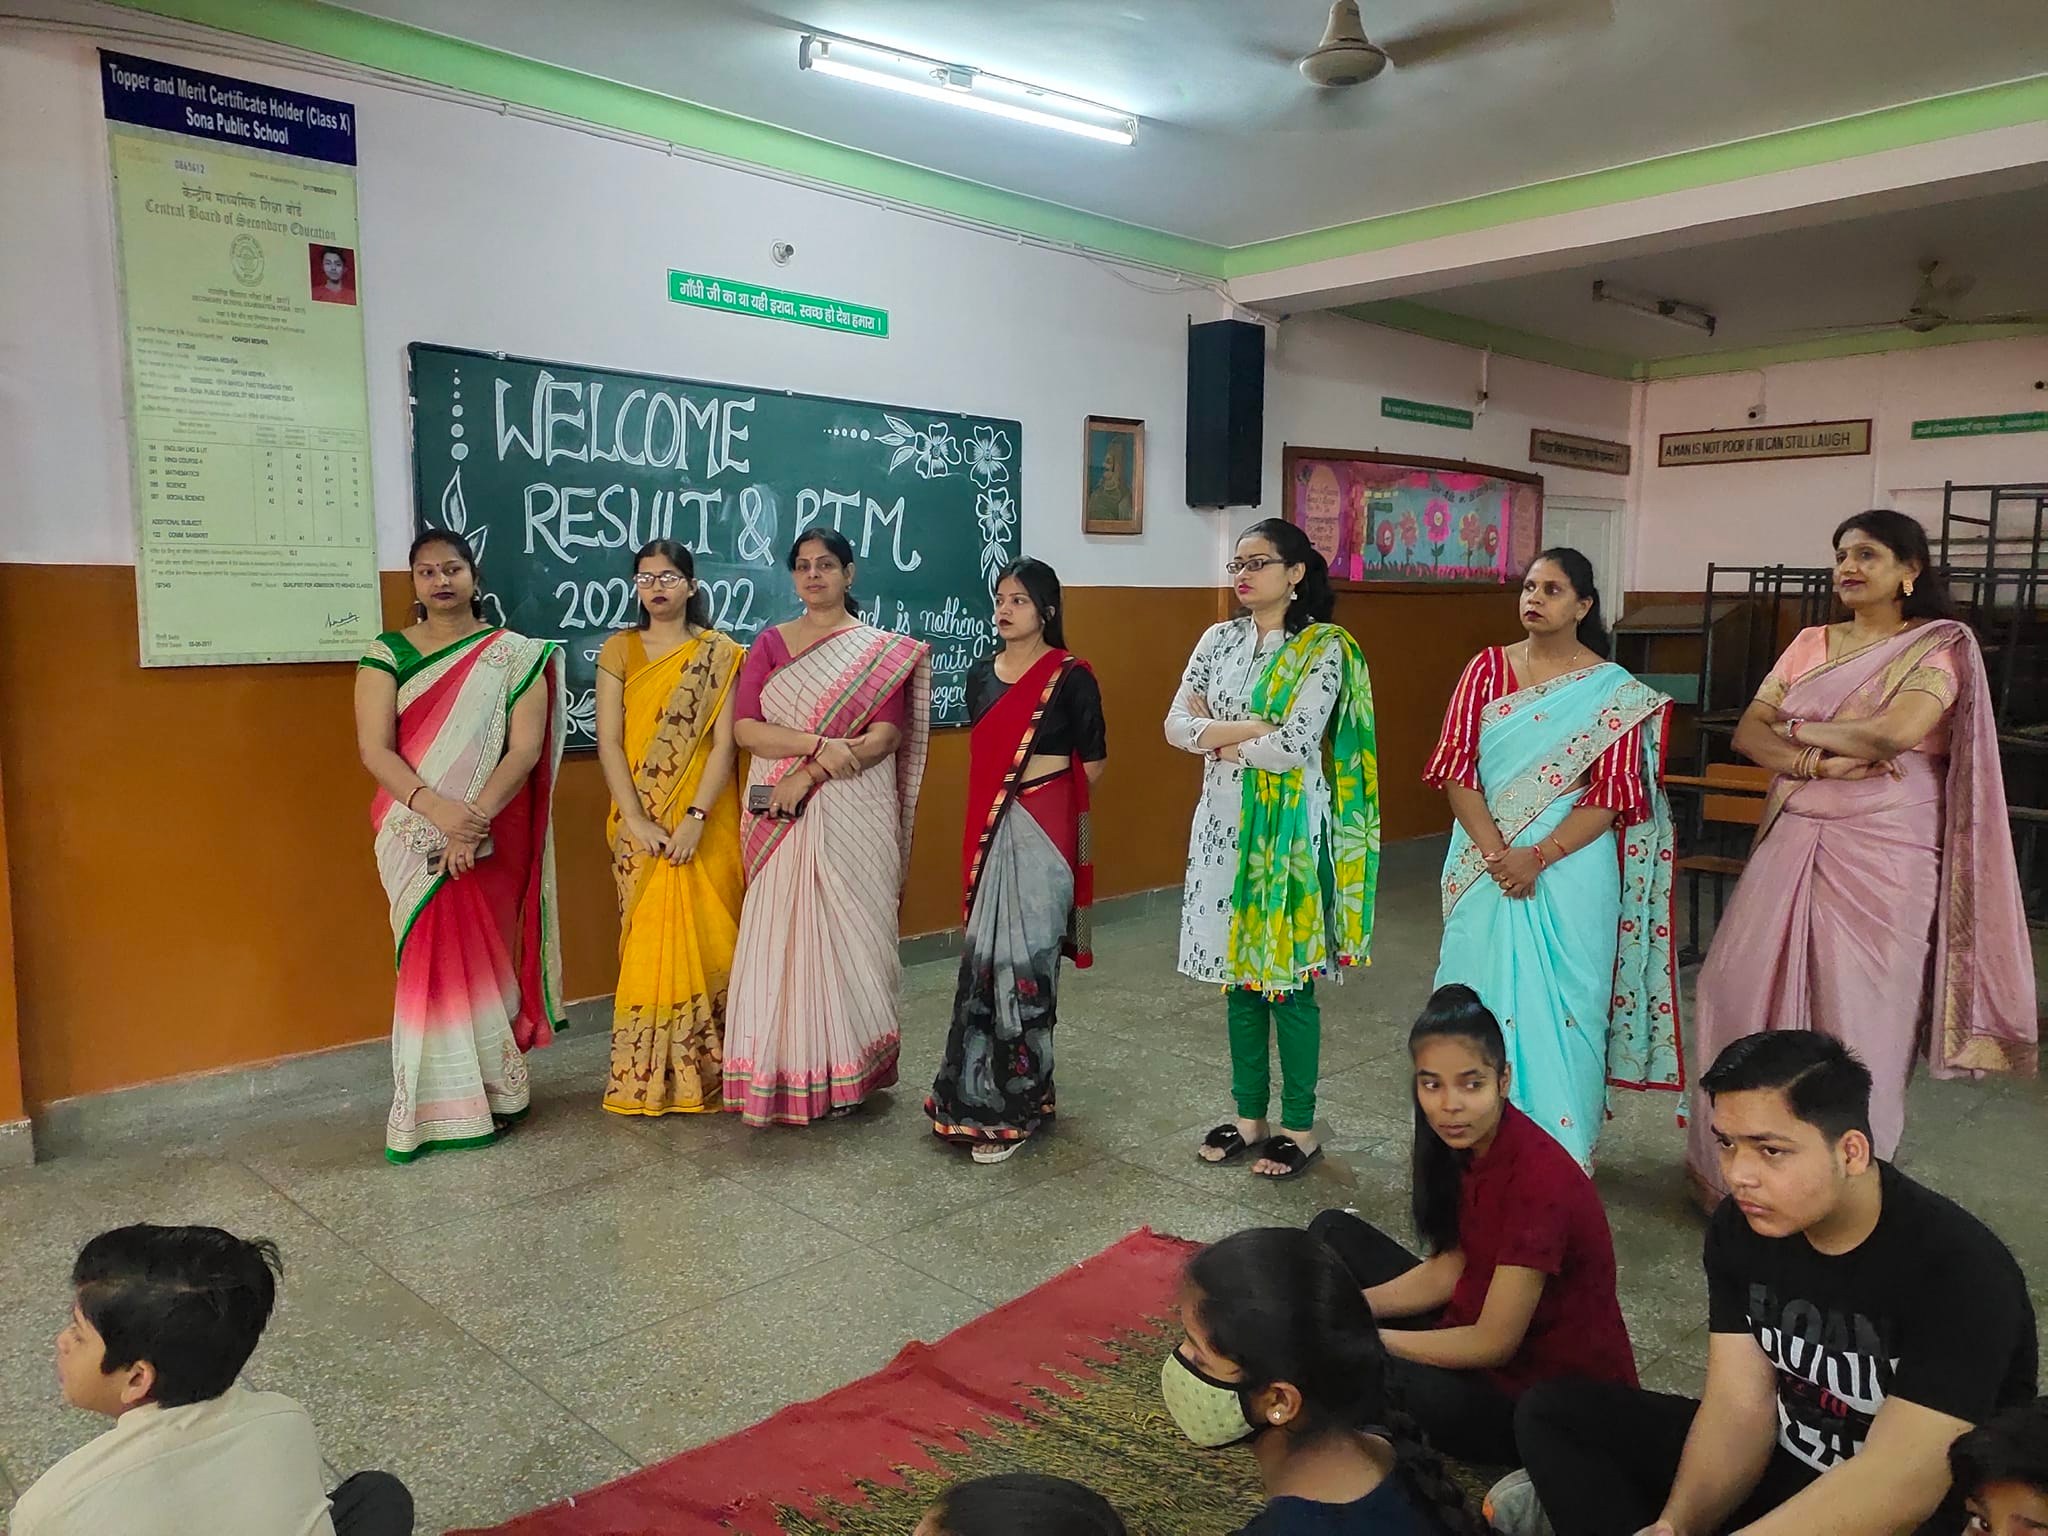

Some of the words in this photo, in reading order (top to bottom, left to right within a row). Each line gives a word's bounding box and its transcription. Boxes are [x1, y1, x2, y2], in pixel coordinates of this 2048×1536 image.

[109, 63, 150, 92] Topper
[154, 76, 174, 95] and
[177, 78, 206, 102] Merit
[209, 85, 267, 114] Certificate
[269, 98, 304, 122] Holder
[306, 106, 337, 129] (Class
[339, 113, 350, 136] X)
[185, 107, 214, 130] Sona
[217, 113, 250, 137] Public
[253, 122, 289, 145] School
[145, 199, 185, 218] Central
[189, 206, 221, 224] Board
[224, 211, 233, 226] of
[235, 213, 288, 236] Secondary
[290, 222, 336, 241] Education
[706, 282, 721, 302] जी
[722, 290, 737, 304] का
[738, 293, 749, 307] था
[751, 292, 768, 312] यही
[824, 304, 835, 323] हो
[836, 306, 850, 326] देश
[494, 370, 756, 478] WELCOME
[1665, 446, 1672, 457] A
[1673, 443, 1691, 456] MAN
[1692, 442, 1700, 455] IS
[1702, 441, 1721, 454] NOT
[1722, 439, 1745, 454] POOR
[1766, 436, 1784, 450] CAN
[1785, 435, 1809, 449] STILL
[1811, 432, 1850, 447] LAUGH
[523, 482, 722, 564] RESULT
[738, 486, 775, 566] &
[891, 600, 911, 635] is
[919, 595, 991, 658] nothing
